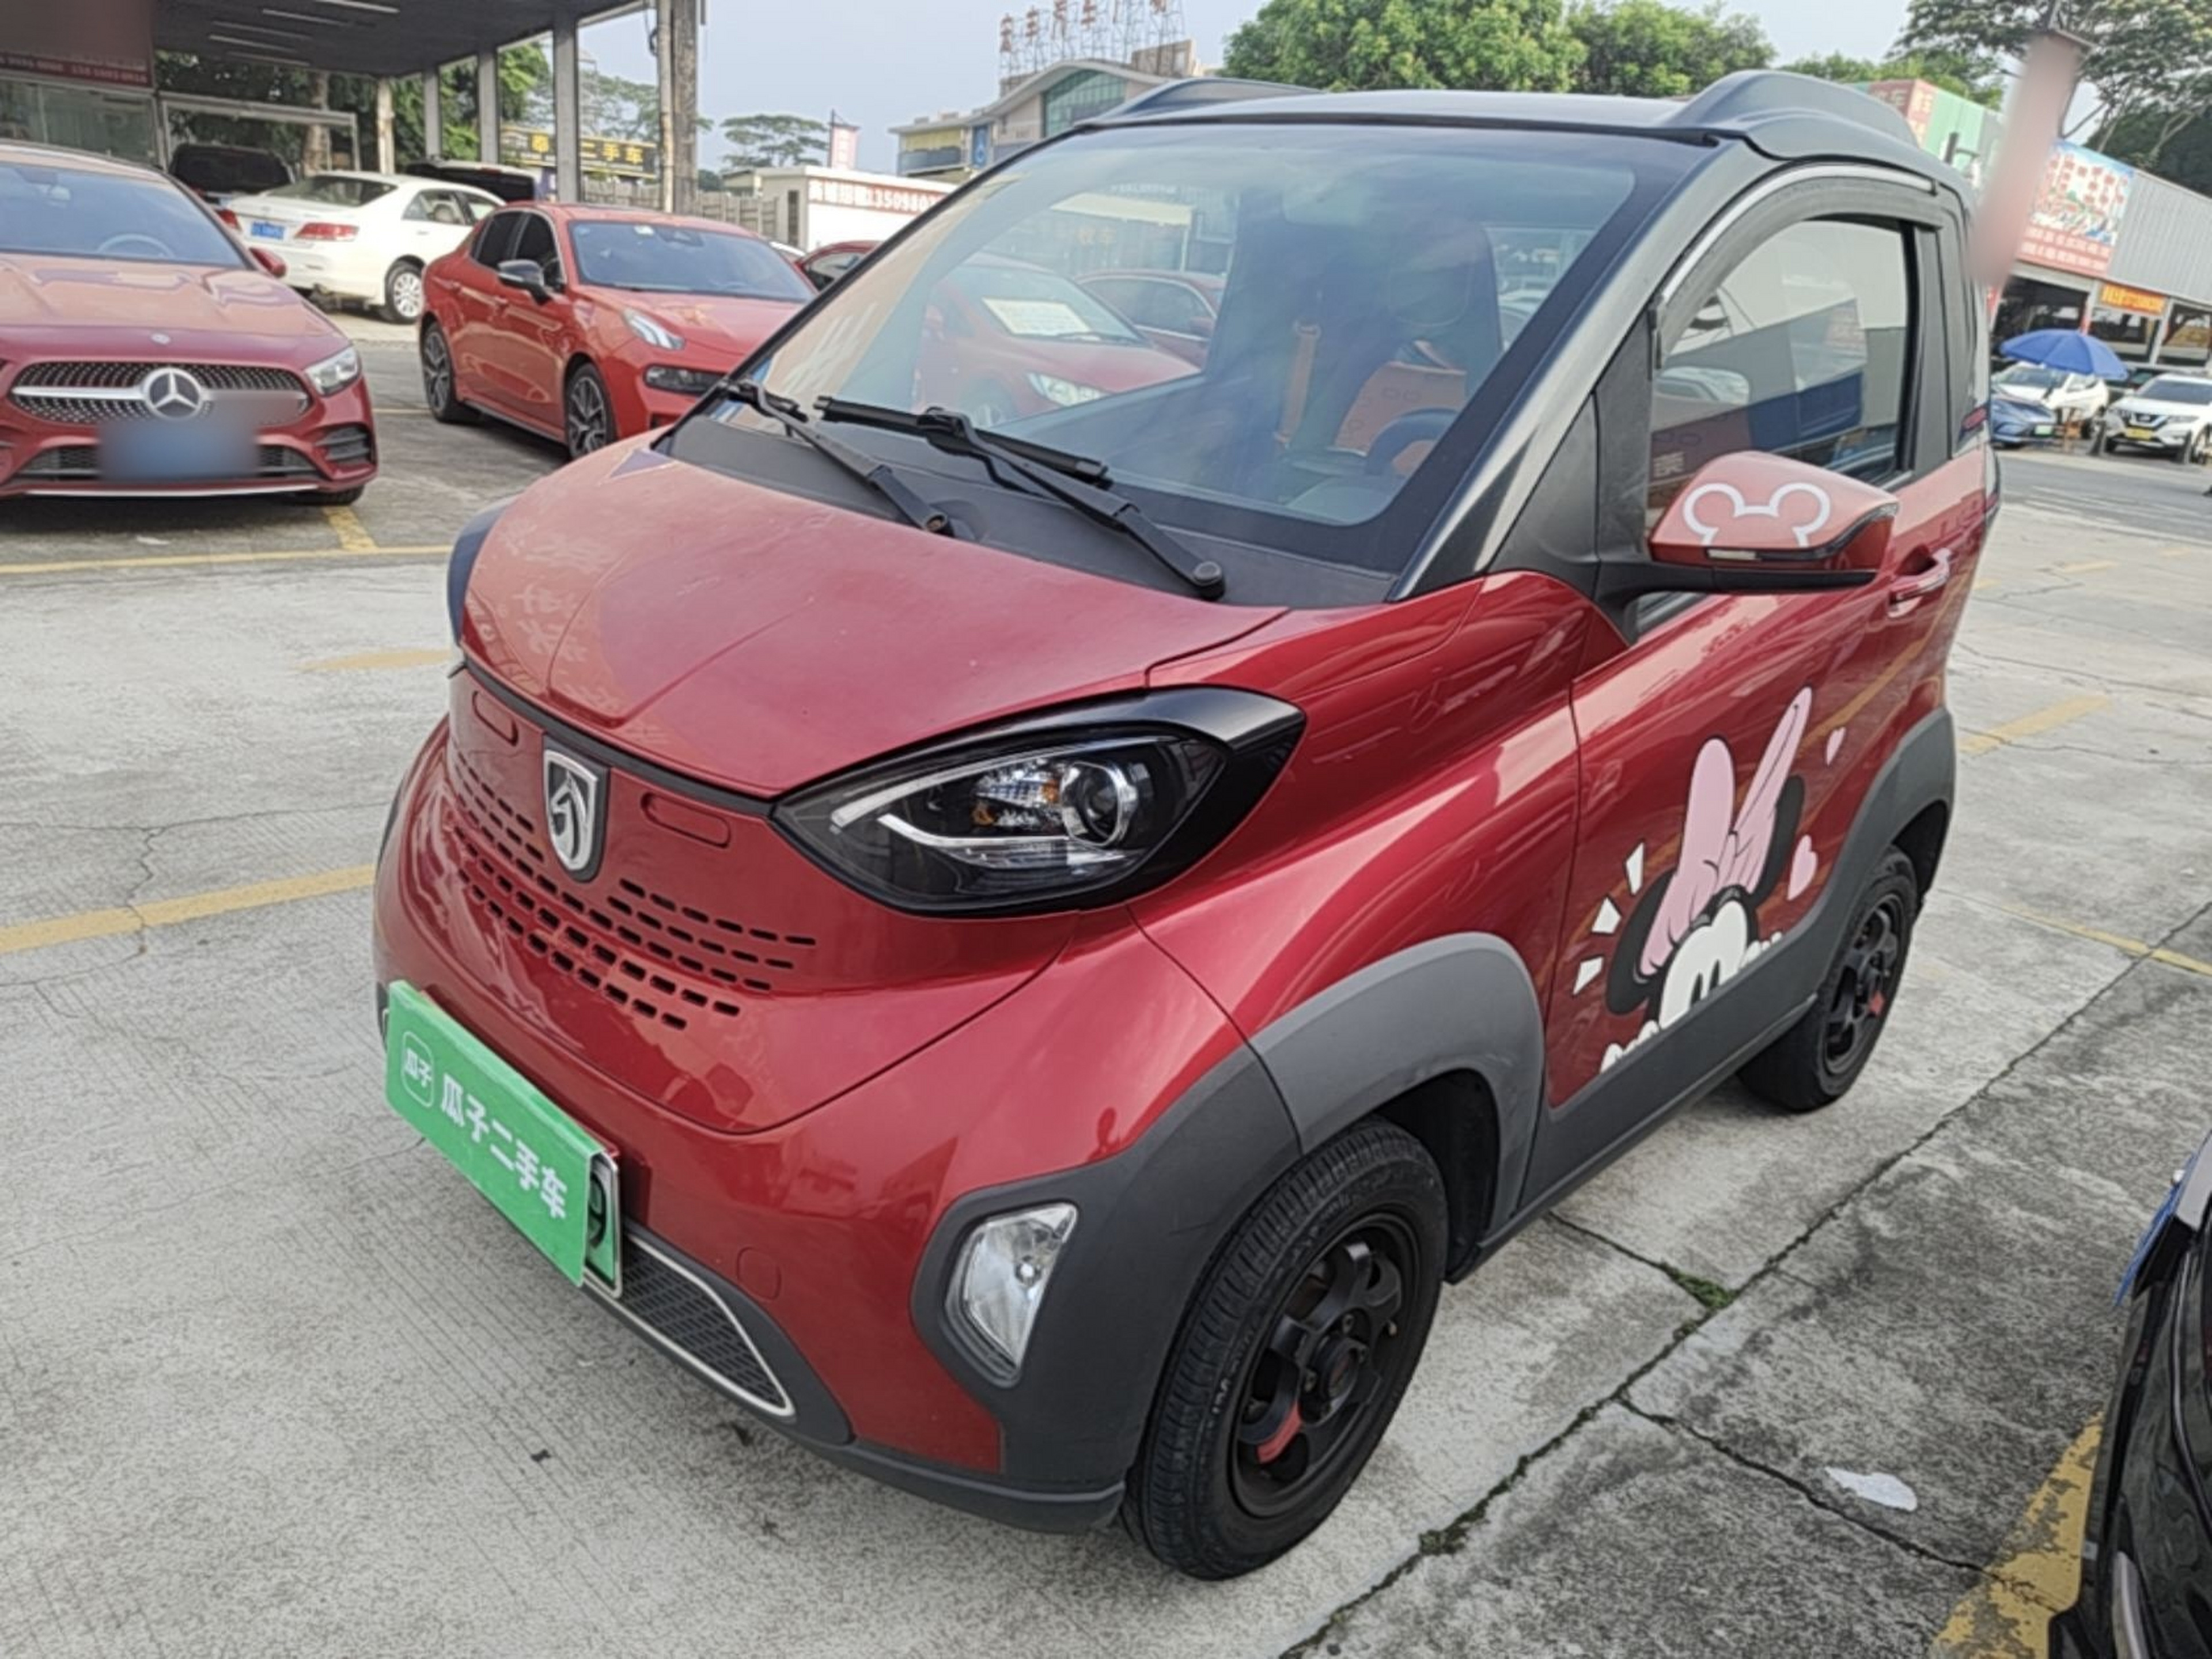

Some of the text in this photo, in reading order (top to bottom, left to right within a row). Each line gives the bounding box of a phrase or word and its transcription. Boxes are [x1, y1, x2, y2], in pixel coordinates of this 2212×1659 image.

[404, 1048, 431, 1088] 瓜子
[441, 1073, 567, 1219] 瓜子二手车
